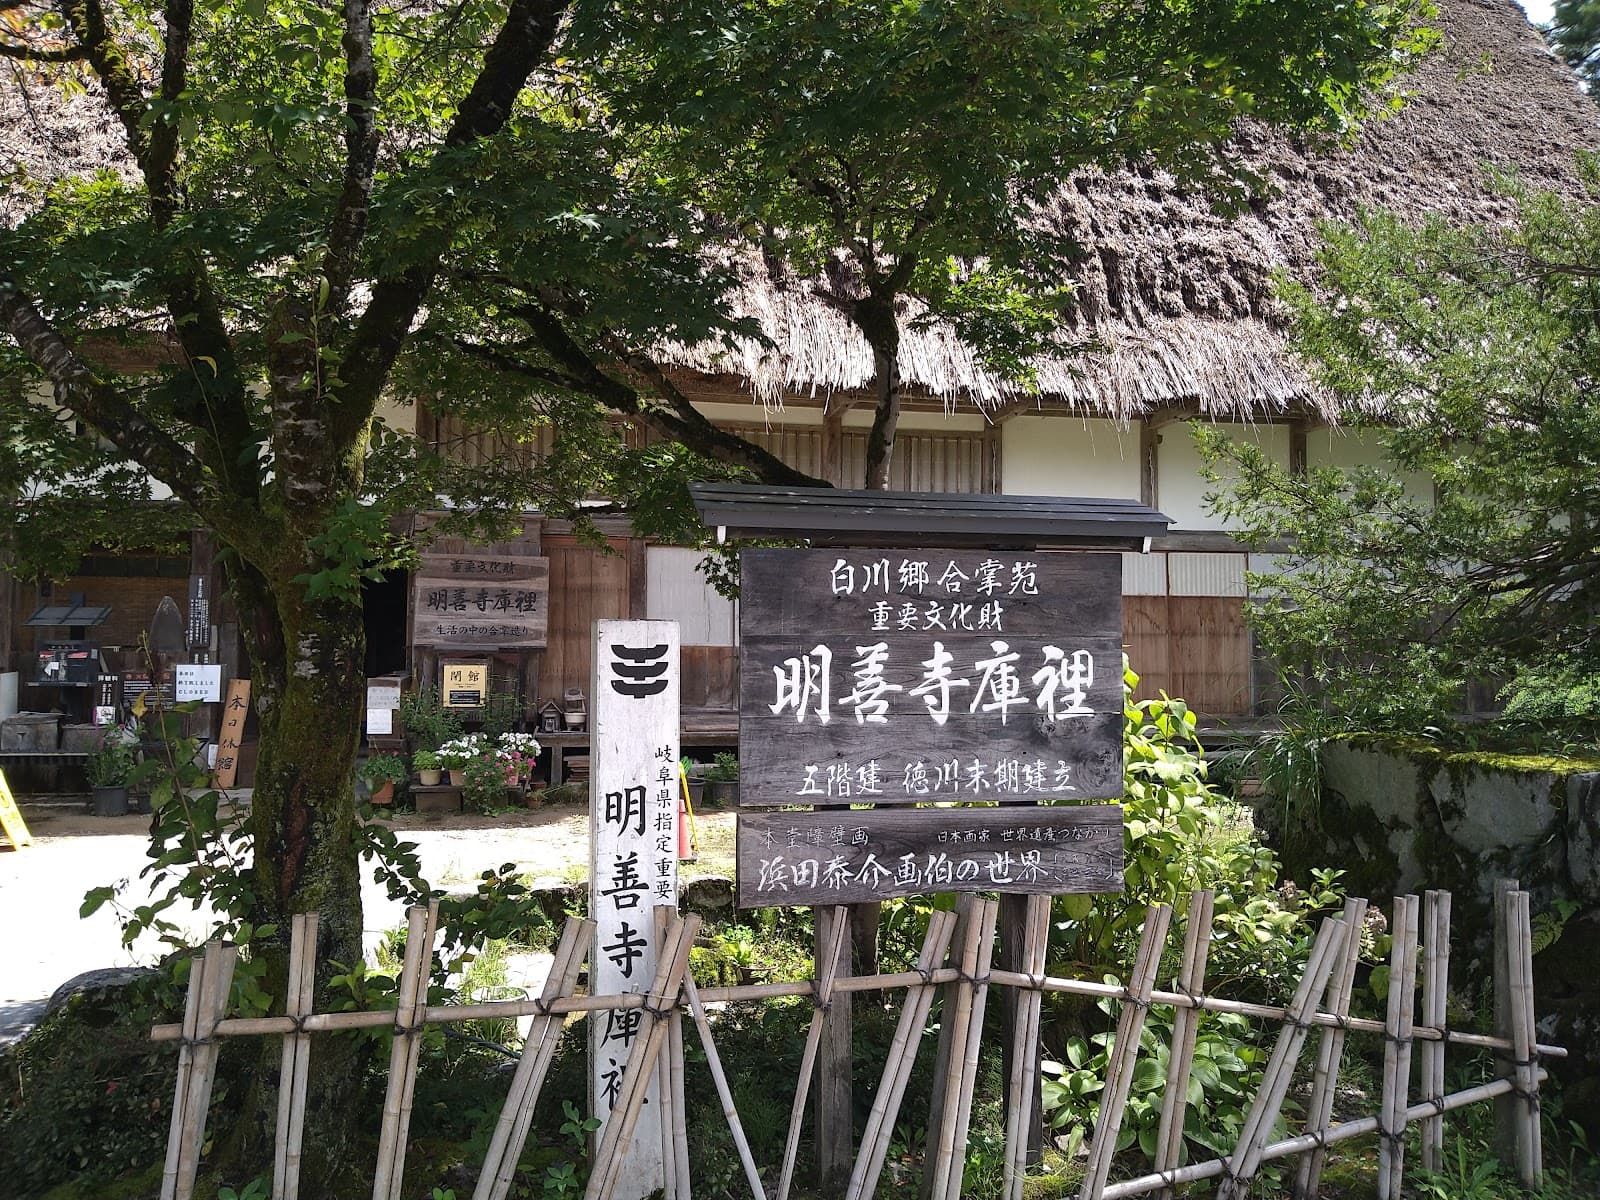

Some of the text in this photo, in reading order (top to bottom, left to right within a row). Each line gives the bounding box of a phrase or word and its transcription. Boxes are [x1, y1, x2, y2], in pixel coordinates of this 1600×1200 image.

[451, 559, 514, 575] 重要文化財
[829, 558, 1039, 596] 白川郷合掌苑
[427, 587, 537, 613] 明善寺庫裡
[867, 601, 1004, 631] 重要文化財
[768, 640, 1096, 726] 明善寺庫裡
[653, 744, 675, 905] 岐阜県指定重要
[937, 829, 991, 844] 日本画家
